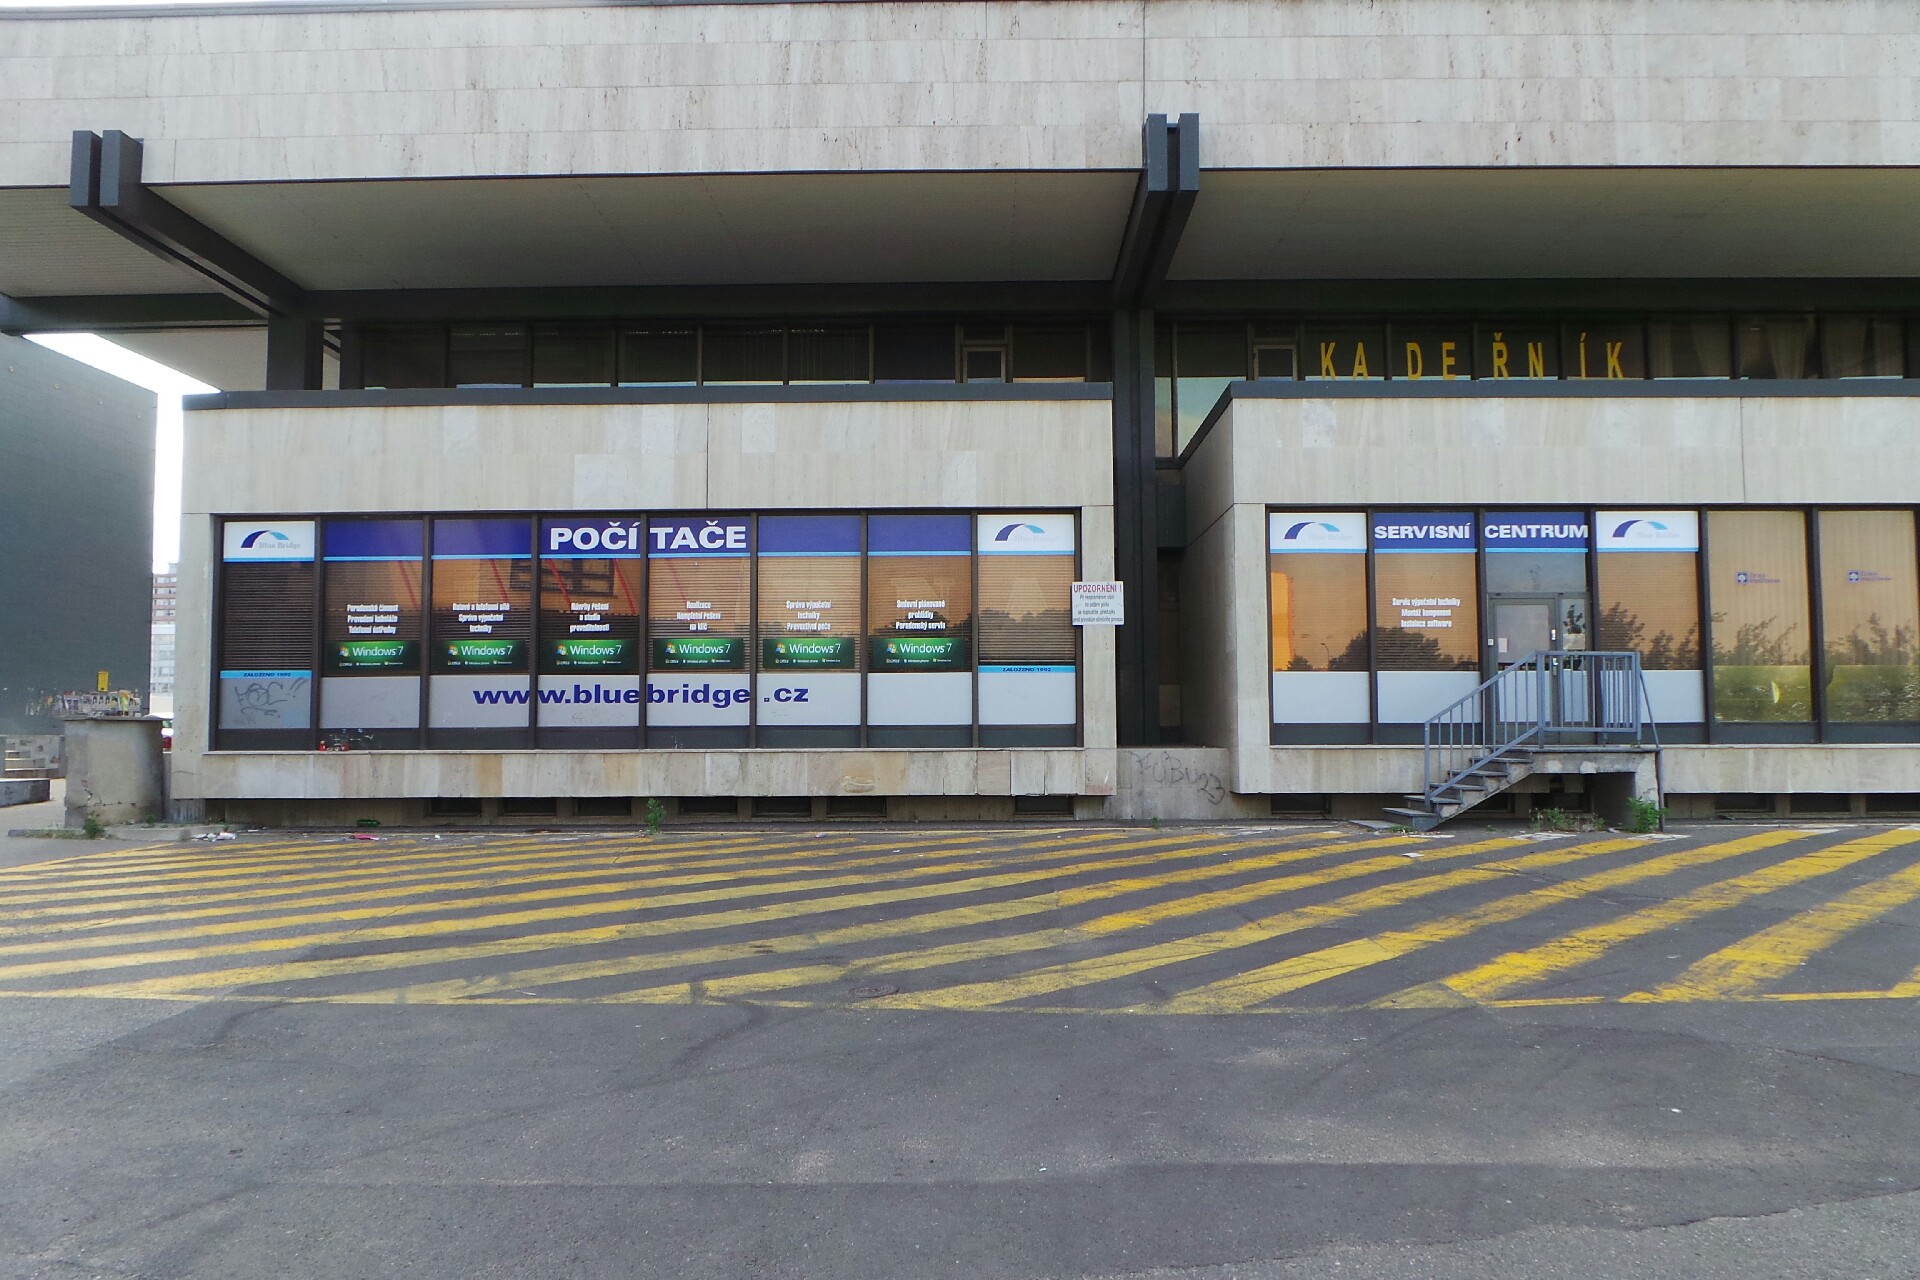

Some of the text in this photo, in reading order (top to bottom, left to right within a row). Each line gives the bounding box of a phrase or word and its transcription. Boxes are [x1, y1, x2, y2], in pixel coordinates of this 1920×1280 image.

[1320, 331, 1624, 380] KADEŘNÍK
[1374, 522, 1471, 539] SERVISNÍ
[1485, 524, 1588, 539] CENTRUM
[352, 646, 396, 656] Windows
[460, 646, 505, 656] Windows
[570, 644, 615, 656] Windows
[678, 644, 724, 654] Windows
[789, 644, 835, 654] Windows
[900, 643, 946, 654] Windows
